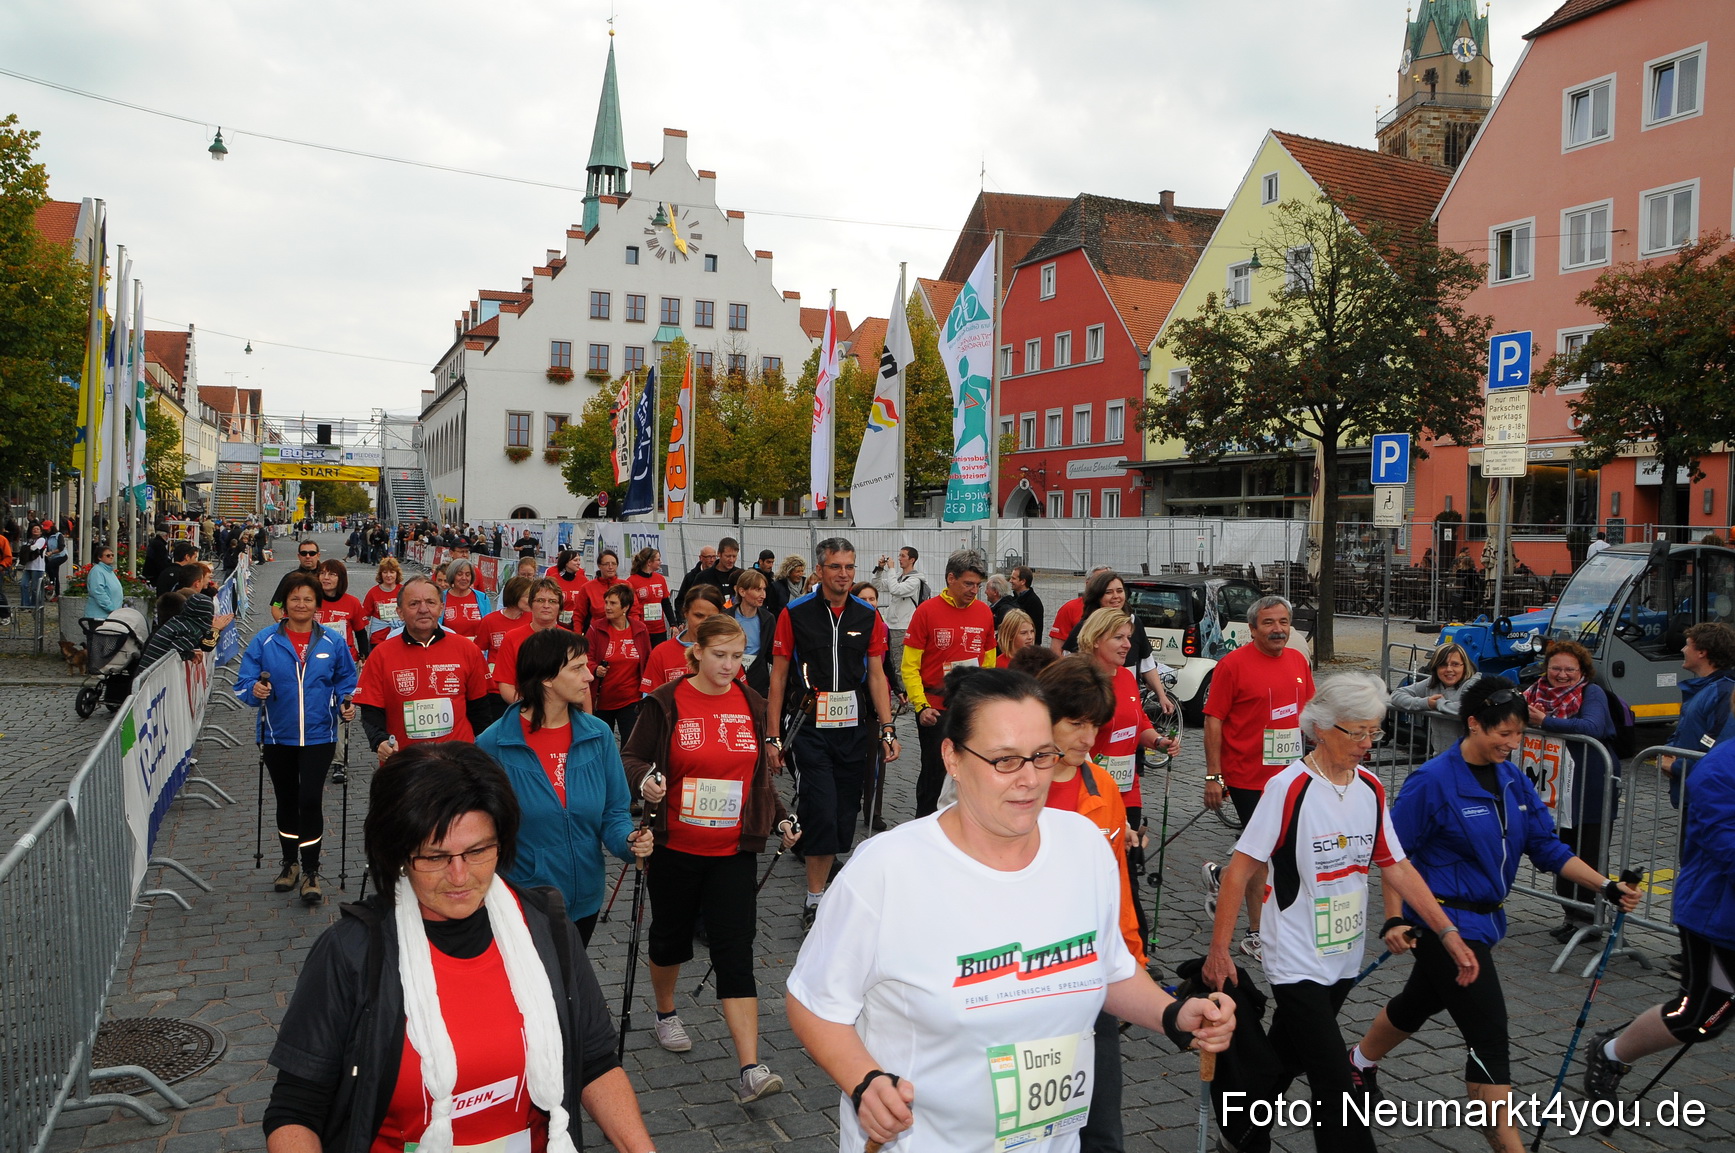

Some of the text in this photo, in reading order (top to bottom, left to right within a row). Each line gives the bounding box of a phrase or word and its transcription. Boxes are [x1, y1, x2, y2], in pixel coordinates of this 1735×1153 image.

[1497, 340, 1521, 382] P
[1489, 403, 1526, 414] Parkschein
[1491, 412, 1523, 421] werktags
[280, 448, 327, 460] BOCK
[1379, 440, 1401, 478] P
[300, 466, 342, 478] START
[1519, 631, 1528, 639] Kg
[398, 681, 416, 689] NEU
[416, 703, 435, 711] Franz
[829, 704, 855, 717] 8017
[418, 712, 450, 726] 8010
[720, 713, 751, 721] NEUMARKTER
[680, 732, 701, 741] NEU
[1276, 731, 1292, 740] Josef
[1276, 741, 1301, 754] 8076
[699, 782, 717, 794] Anja
[699, 797, 737, 813] 8025
[1333, 900, 1351, 912] Erna
[1334, 911, 1364, 935] 8033
[1023, 936, 1096, 975] ITALIA
[965, 994, 989, 1005] FEINE
[996, 984, 1052, 1000] ITALIENISCHE
[1023, 1048, 1061, 1070] Doris
[1027, 1070, 1086, 1112] 8062
[455, 1089, 495, 1111] DEHN
[1053, 1111, 1088, 1131] PFLEIDERER
